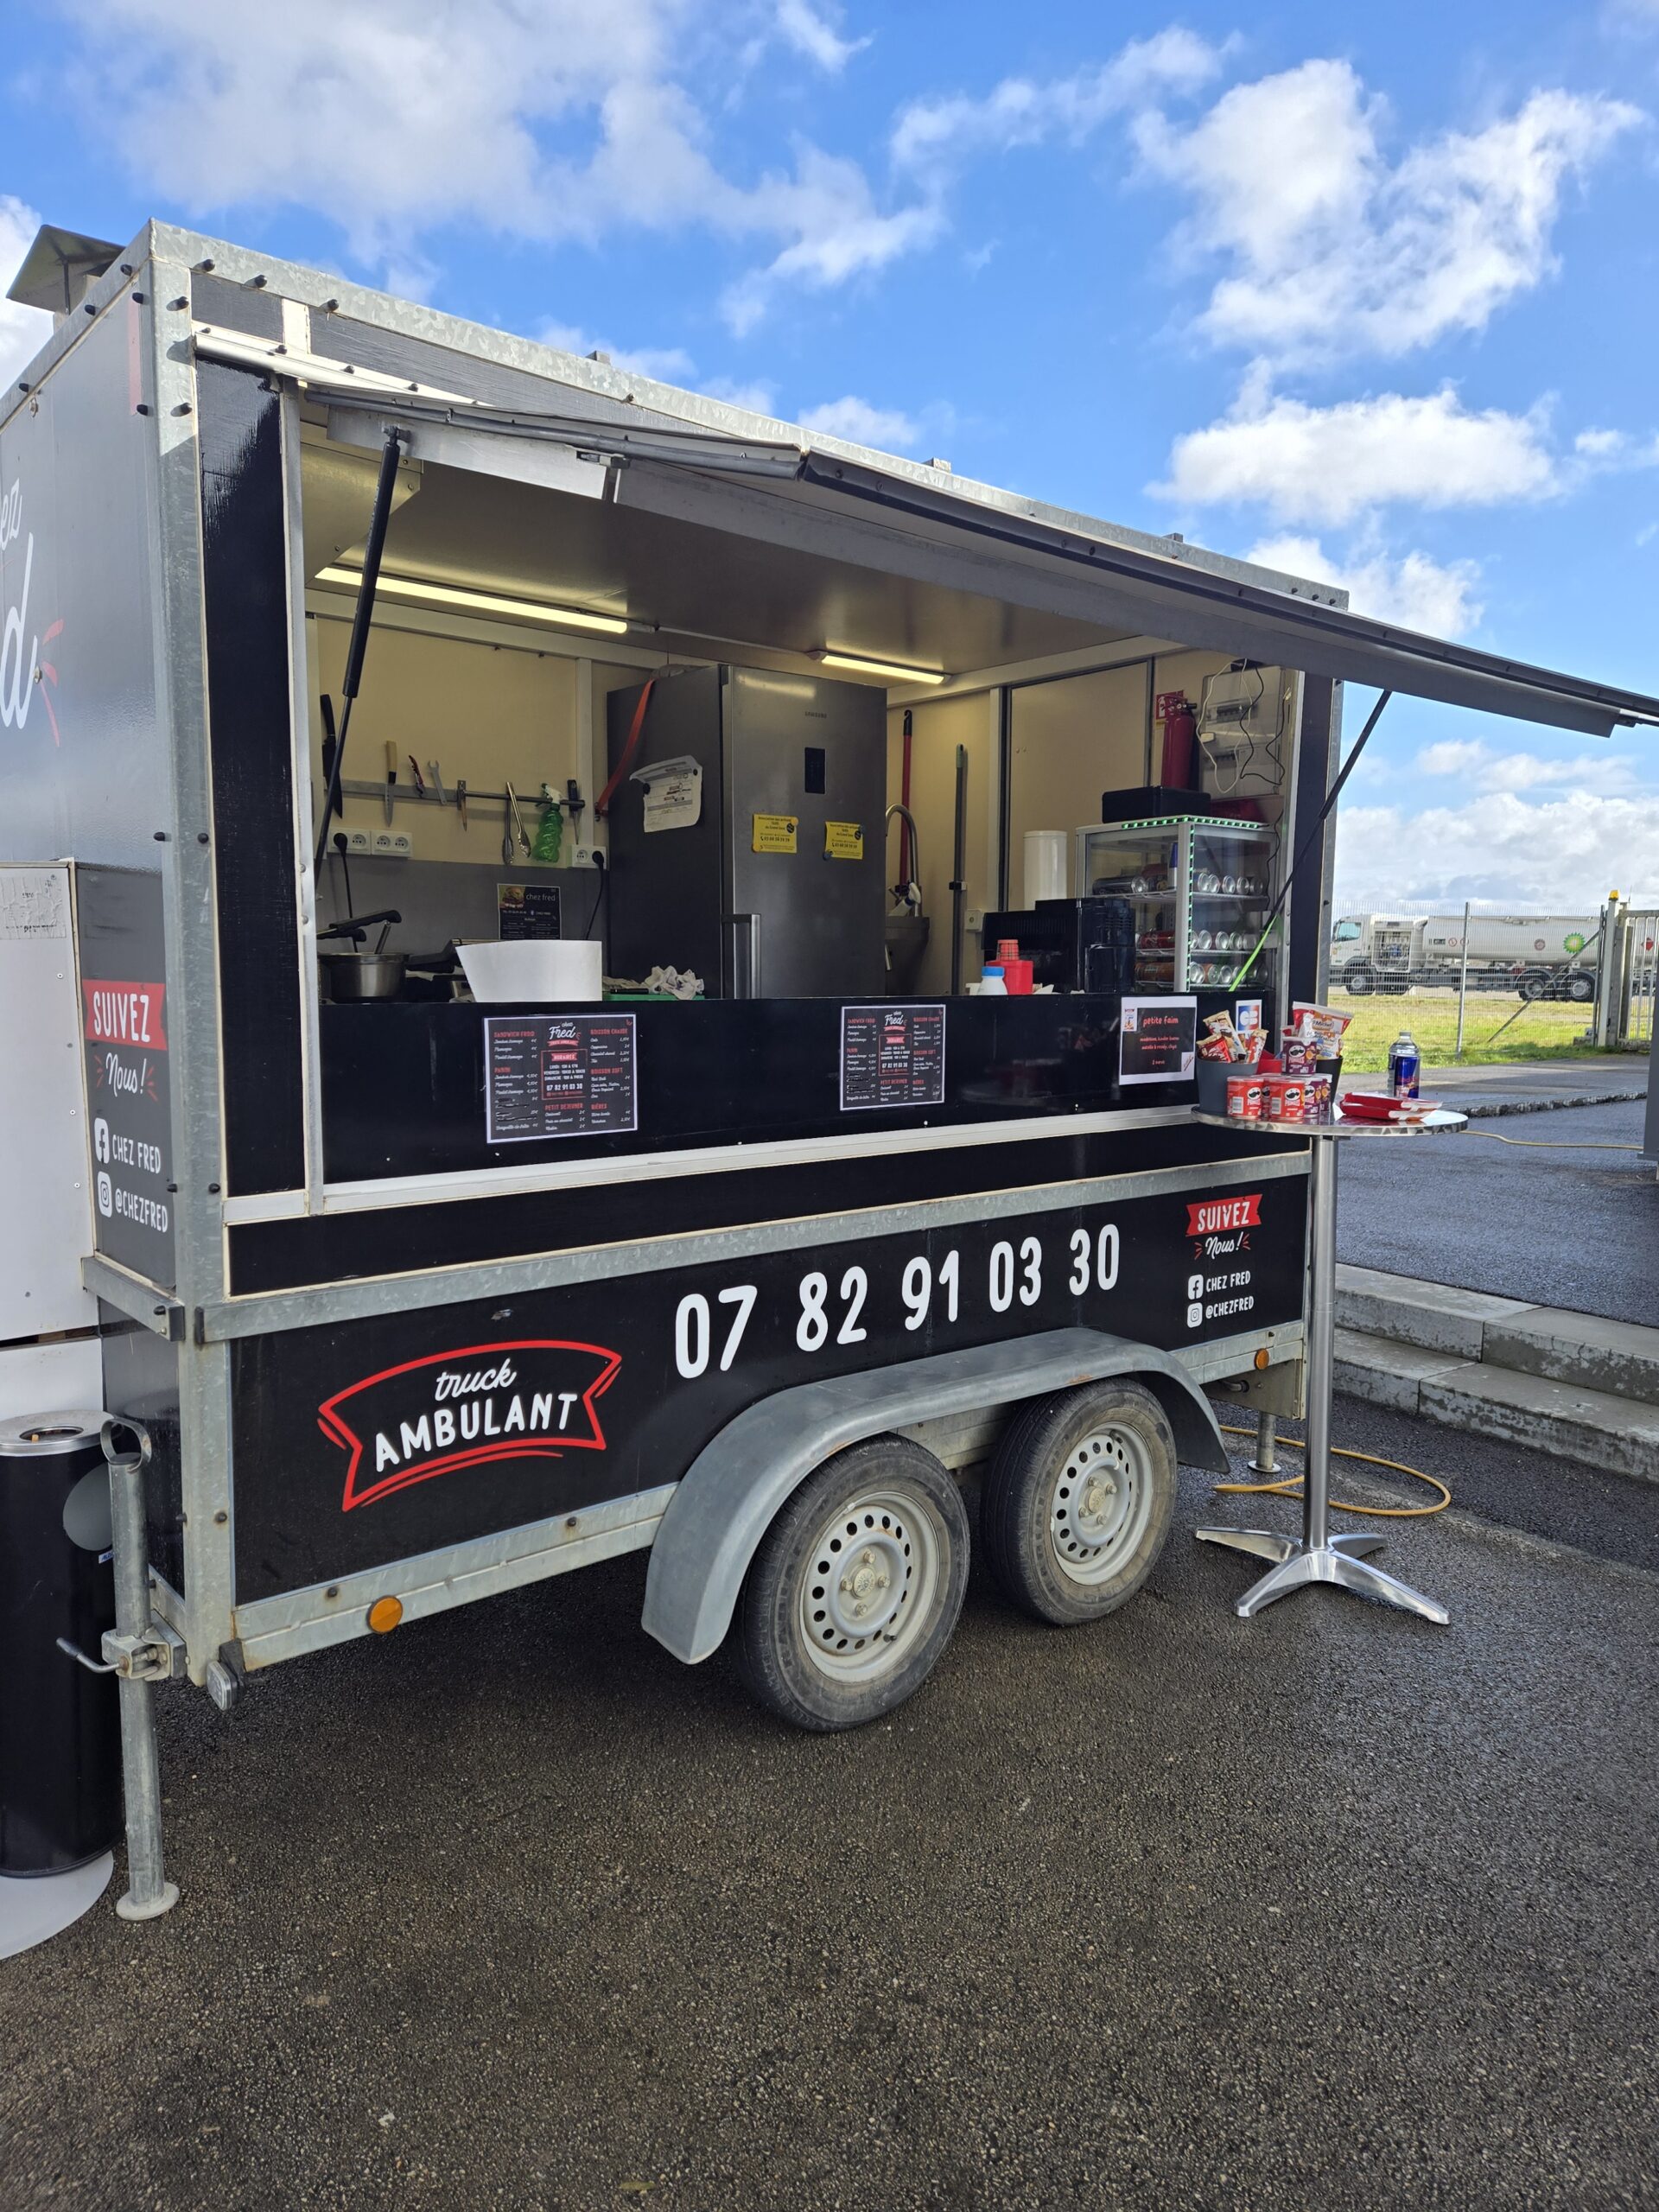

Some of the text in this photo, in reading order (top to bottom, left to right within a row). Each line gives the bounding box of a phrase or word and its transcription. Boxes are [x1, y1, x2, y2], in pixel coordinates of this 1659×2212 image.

[92, 990, 150, 1043] SUIVEZ
[549, 1026, 576, 1040] Fred
[885, 1014, 903, 1026] Fred
[1143, 1016, 1162, 1027] petite
[111, 1134, 161, 1174] CHEZ FRED
[114, 1188, 168, 1234] @CHEZFRED
[1197, 1201, 1251, 1232] SUIVEZ
[1205, 1270, 1251, 1293] CHEZ FRED
[675, 1223, 1120, 1379] 07 82 91 03 30
[1205, 1295, 1255, 1319] @CHEZFRED
[435, 1357, 518, 1402] truck
[374, 1392, 578, 1472] AMBULANT
